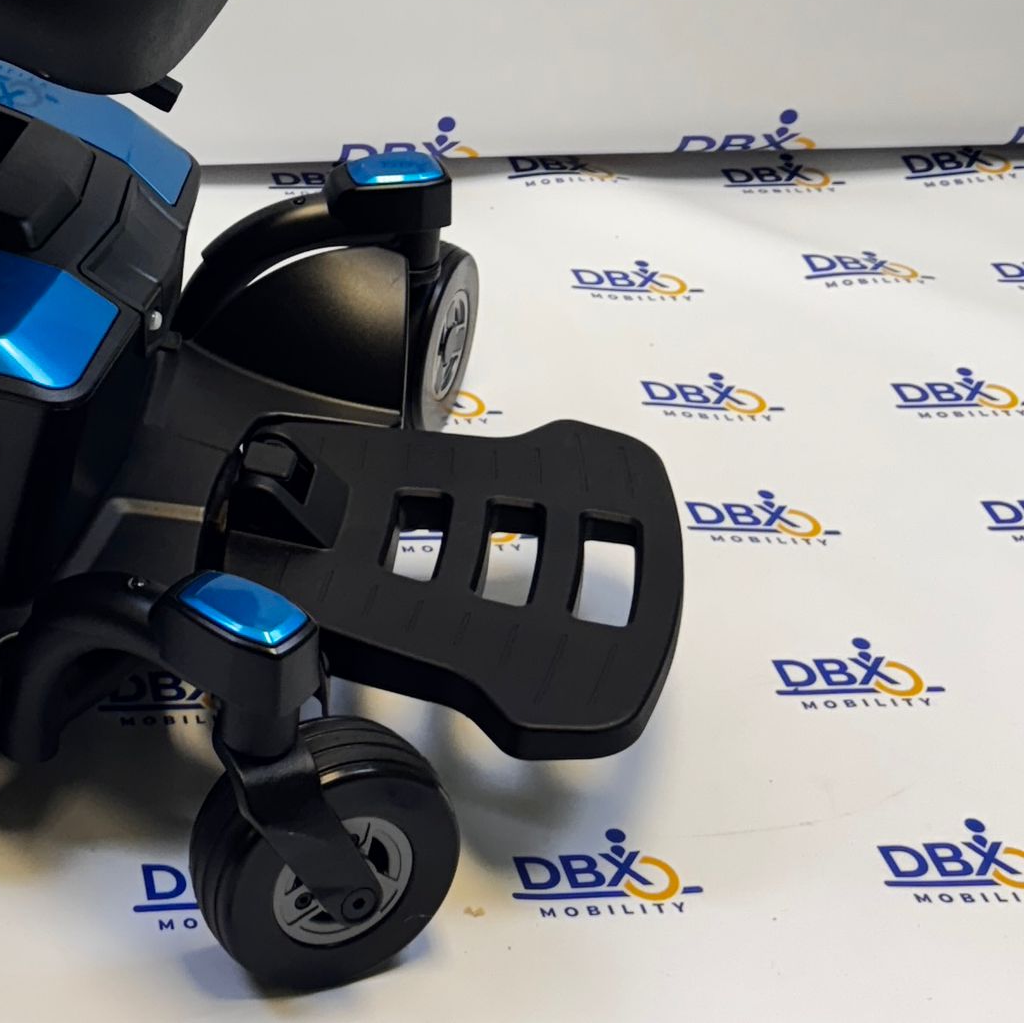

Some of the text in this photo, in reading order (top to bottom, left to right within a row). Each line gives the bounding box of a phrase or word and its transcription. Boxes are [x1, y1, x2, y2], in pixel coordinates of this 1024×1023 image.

[901, 149, 993, 173] DBX
[271, 172, 325, 185] DB
[721, 164, 812, 183] DBX
[571, 268, 668, 289] DBX
[591, 293, 690, 301] MOBILITY
[641, 380, 747, 405] DBX
[891, 380, 999, 403] DBX
[664, 411, 770, 421] MOBILITY
[685, 502, 800, 528] DBX
[711, 535, 826, 546] MOBILITY
[772, 657, 900, 687] DBX
[109, 672, 206, 702] DB
[802, 698, 929, 709] MOBILITY
[120, 715, 206, 726] MOBIL
[877, 842, 1021, 878] DBX
[513, 851, 653, 890] DBX
[914, 892, 1021, 904] MOBILI
[540, 902, 683, 917] MOBILITY
